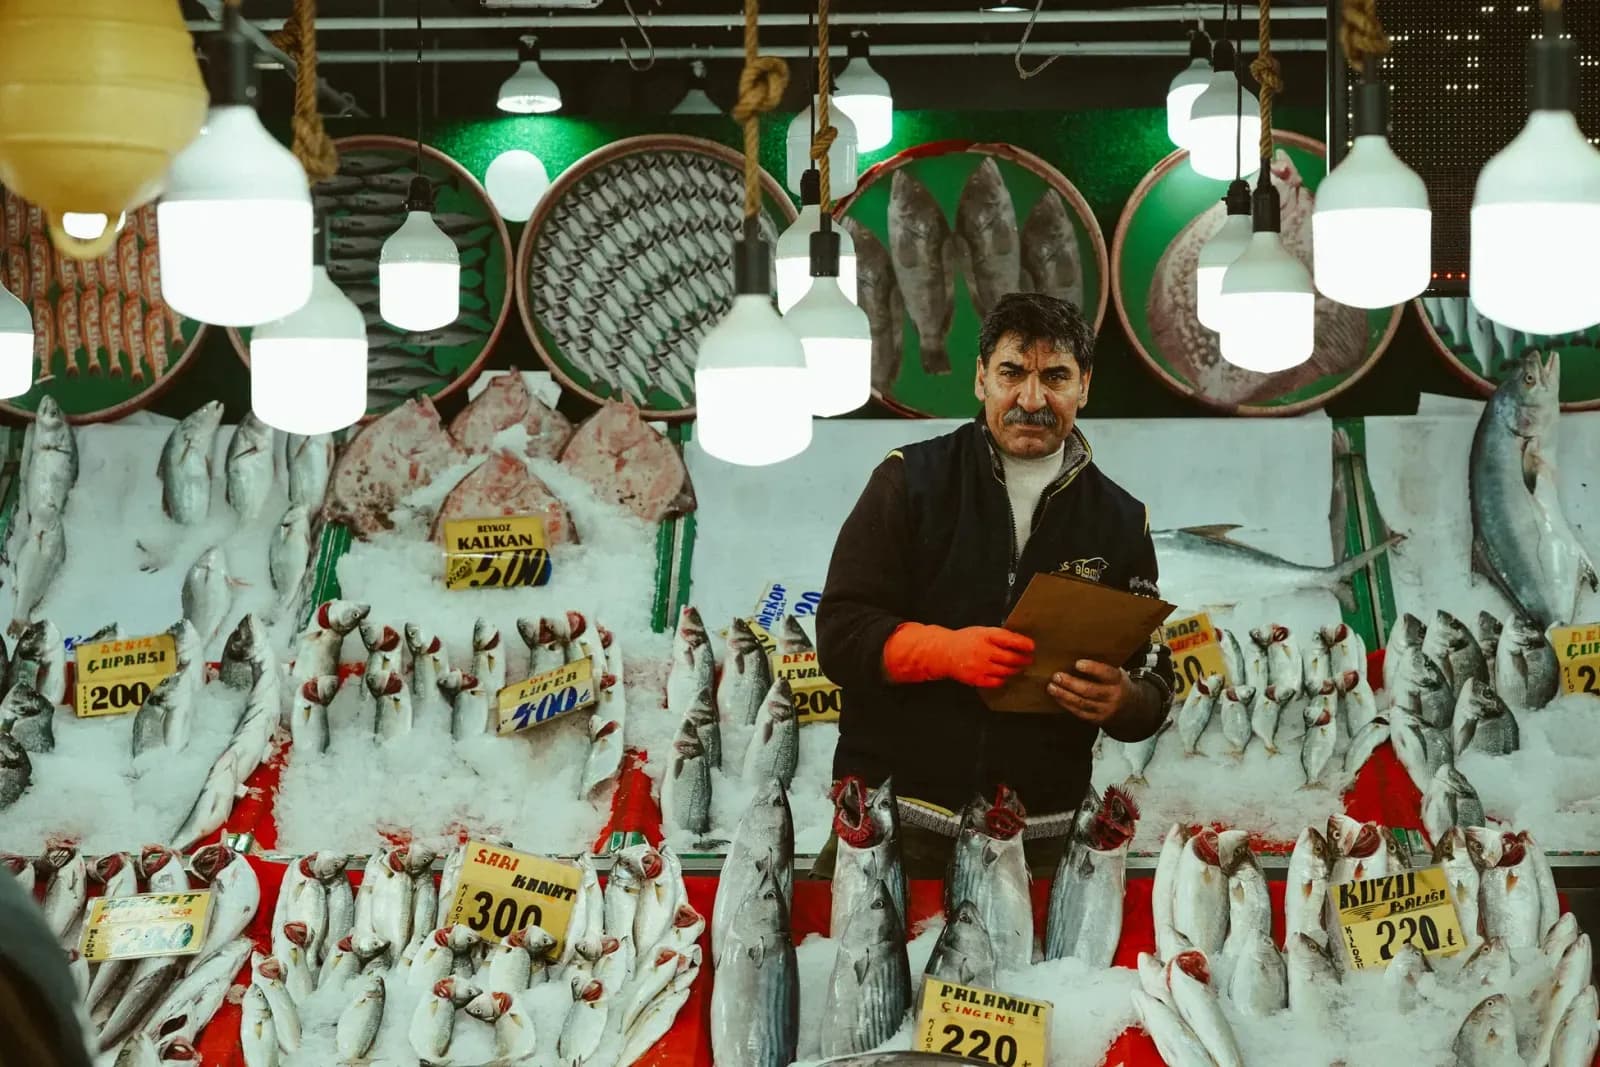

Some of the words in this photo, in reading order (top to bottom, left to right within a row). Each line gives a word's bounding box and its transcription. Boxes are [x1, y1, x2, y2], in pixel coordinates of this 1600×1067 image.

[457, 534, 533, 550] KALKAN
[477, 524, 511, 533] BEYKOZ
[90, 681, 151, 711] 200
[512, 686, 578, 731] 400
[474, 849, 519, 871] SARI
[511, 874, 577, 901] KANAT
[1339, 872, 1415, 910] KUZU
[468, 891, 542, 938] 300
[1376, 915, 1440, 960] 220
[940, 984, 1046, 1017] PALAMUT
[941, 1001, 1016, 1025] ÇİNGENE
[941, 1024, 1018, 1067] 220
